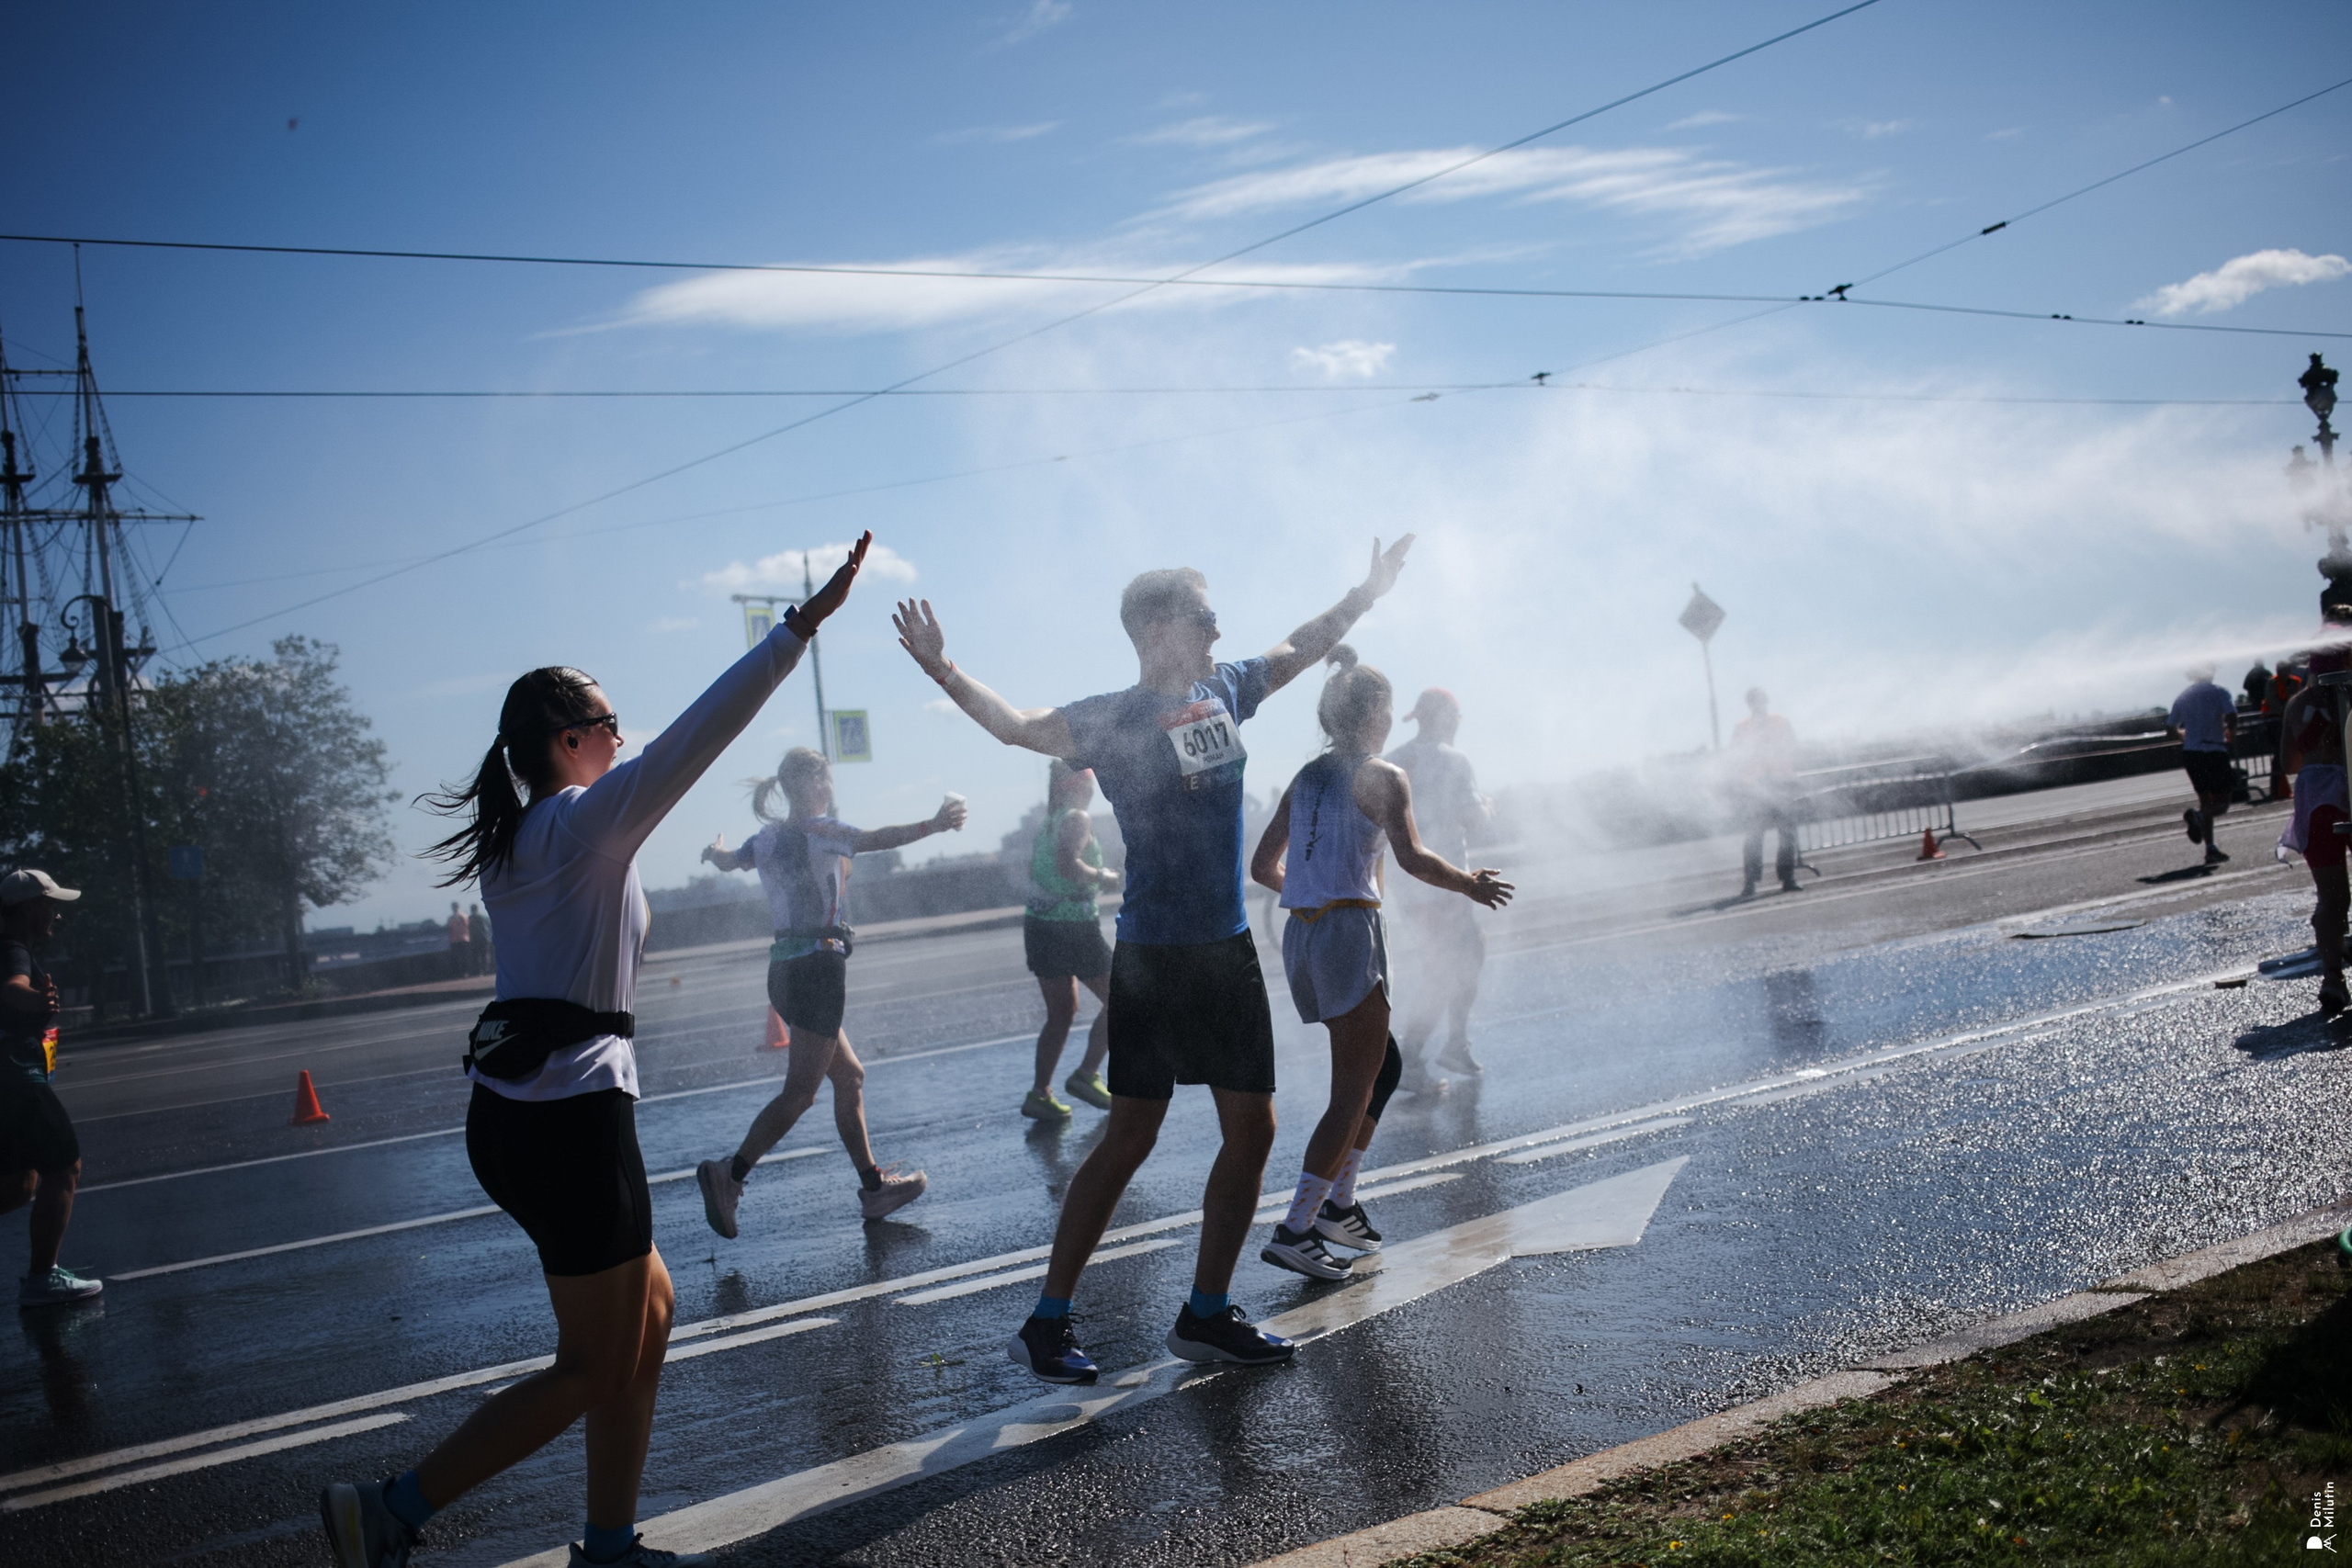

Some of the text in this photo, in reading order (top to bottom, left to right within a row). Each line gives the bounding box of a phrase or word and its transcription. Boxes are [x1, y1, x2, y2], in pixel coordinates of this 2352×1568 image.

[1182, 721, 1229, 757] 6017
[1204, 752, 1224, 762] РОМАН
[477, 1020, 510, 1042] NIKE
